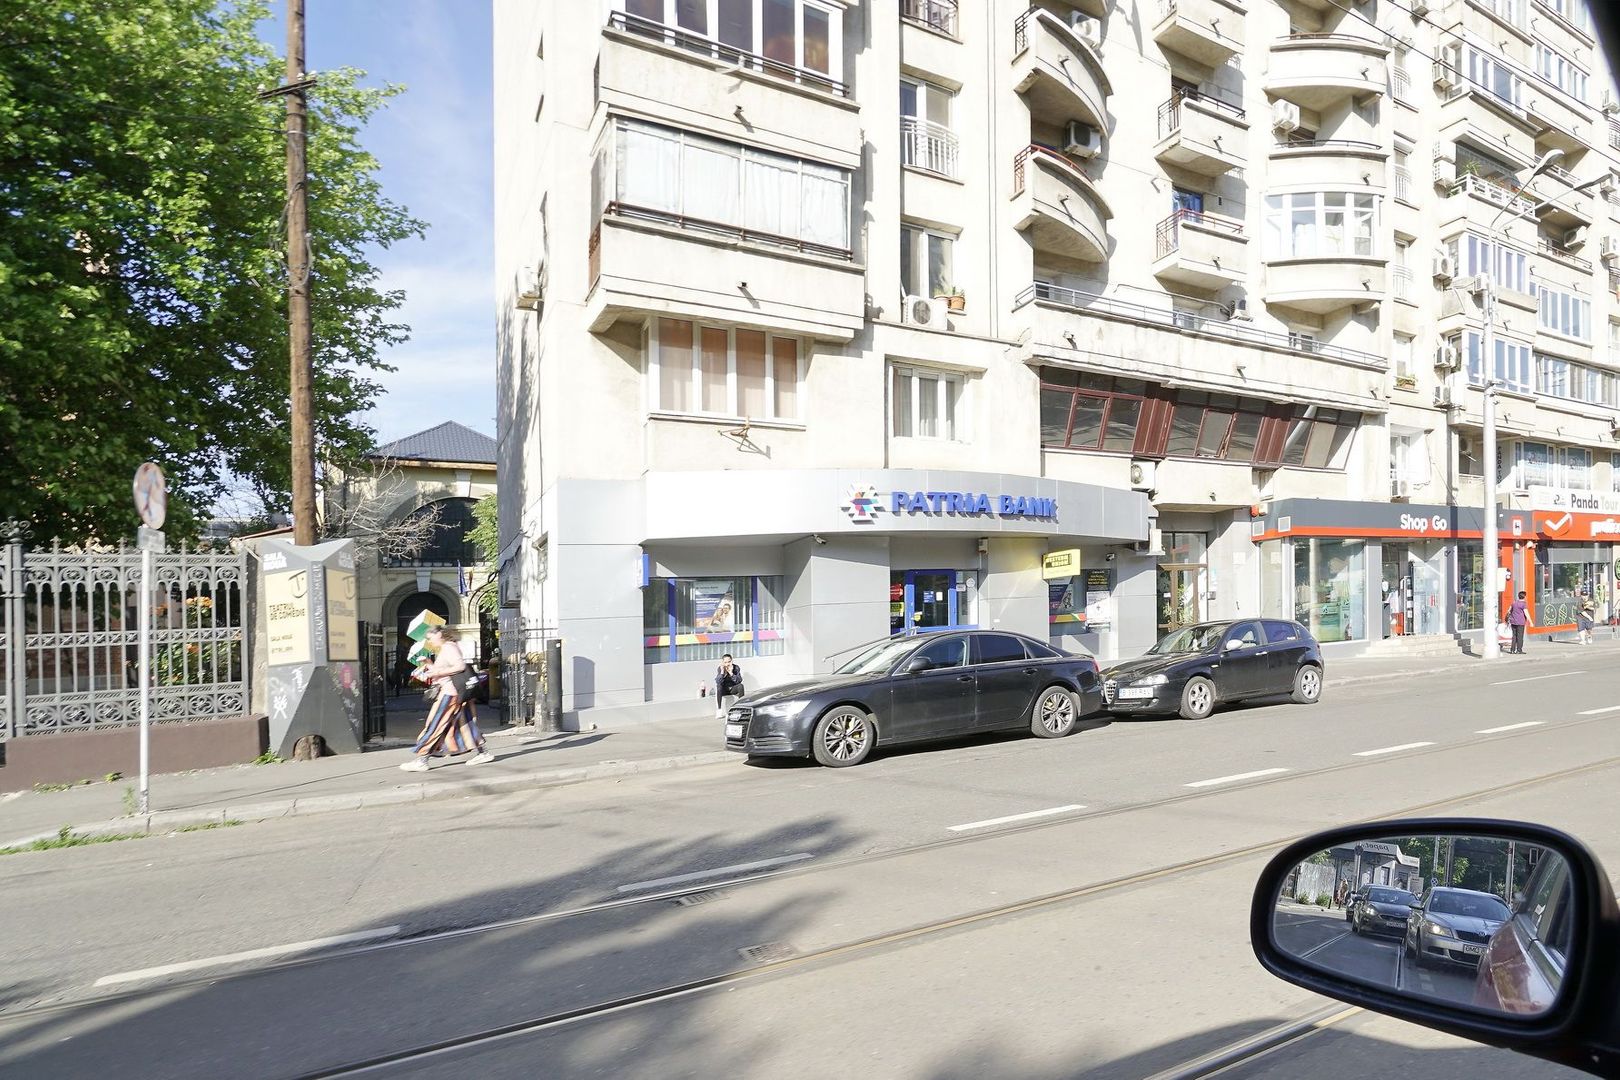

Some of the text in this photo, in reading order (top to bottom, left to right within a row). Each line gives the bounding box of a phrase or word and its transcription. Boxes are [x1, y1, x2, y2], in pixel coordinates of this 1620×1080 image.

[891, 491, 1059, 517] PATRIA BANK
[1571, 493, 1599, 509] Panda
[1601, 496, 1618, 511] Tour
[1400, 513, 1448, 534] Shop Go
[269, 602, 295, 613] TEATRUL
[279, 608, 306, 620] COMEDIE
